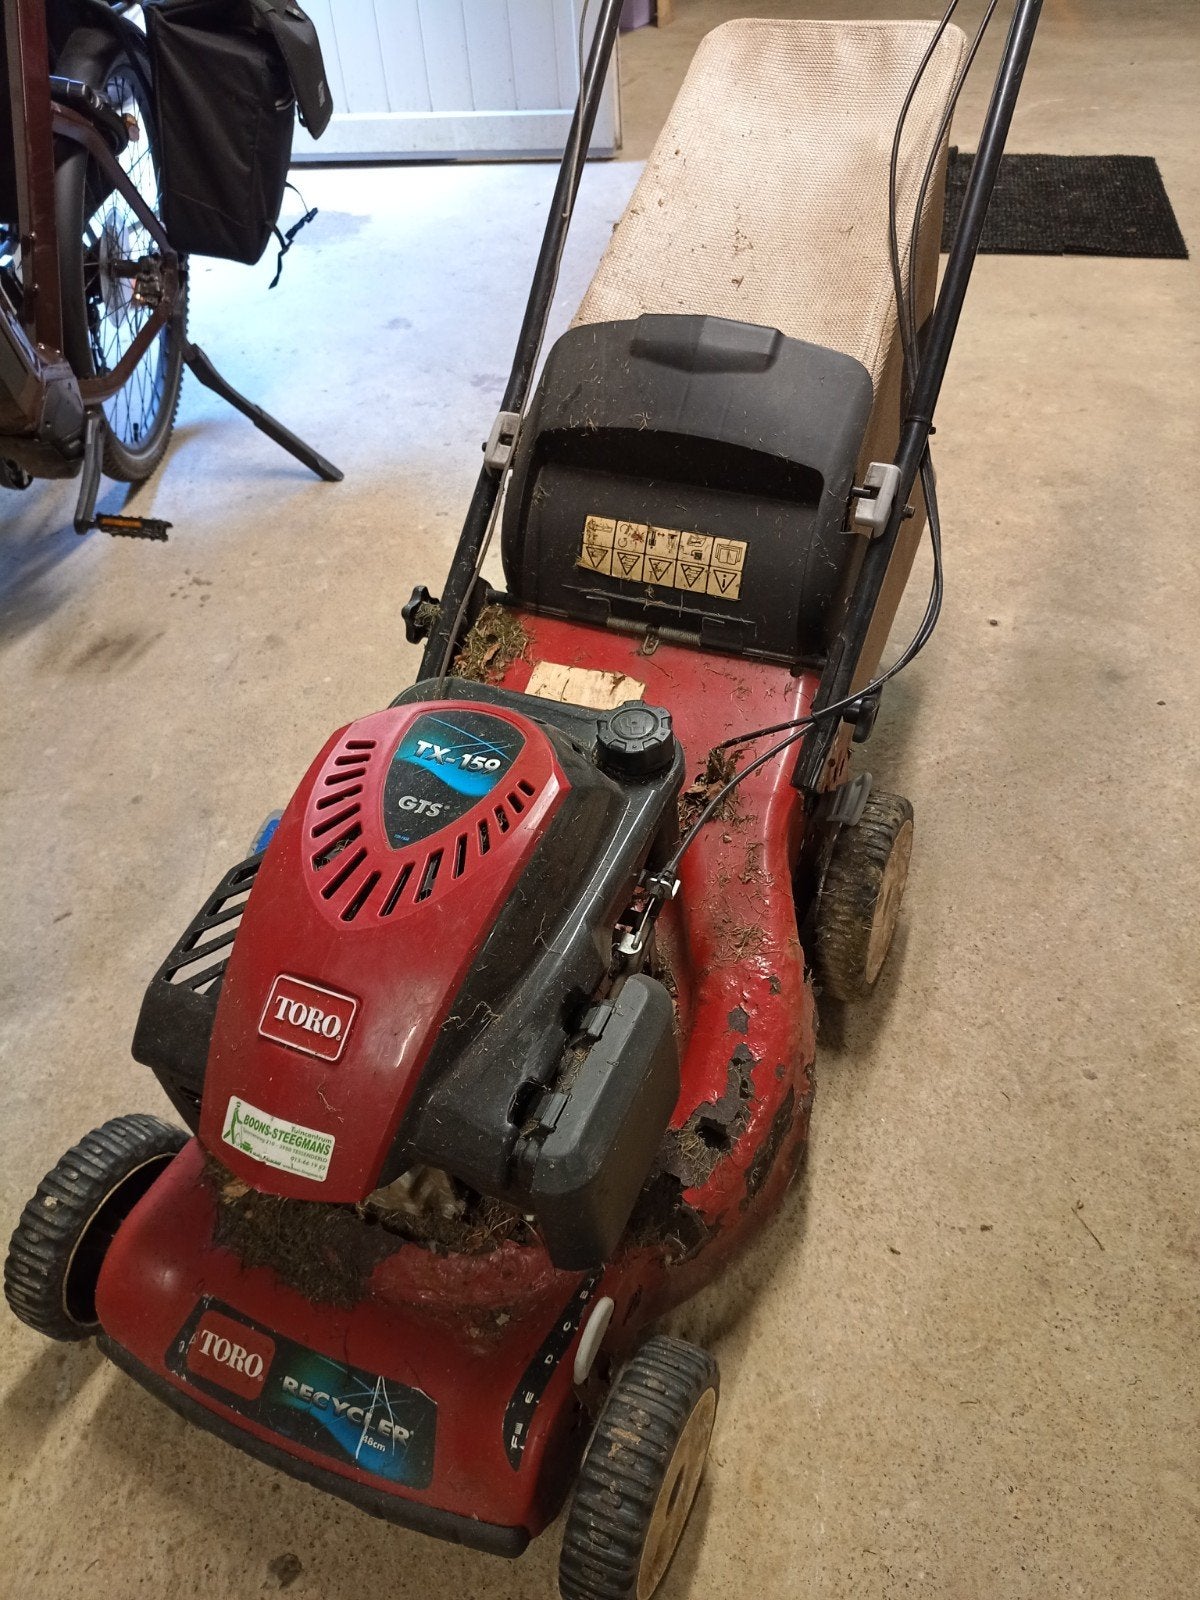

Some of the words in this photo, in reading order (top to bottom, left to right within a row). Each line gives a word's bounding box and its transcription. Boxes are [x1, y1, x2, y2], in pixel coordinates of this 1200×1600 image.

[413, 739, 501, 775] TX-159
[398, 795, 443, 817] GTS
[274, 995, 342, 1038] TORO
[243, 1114, 331, 1156] BOONS-STEEGMANS
[198, 1329, 263, 1379] TORO
[544, 1354, 554, 1365] D
[562, 1321, 572, 1331] C
[282, 1374, 412, 1446] RECYCLER
